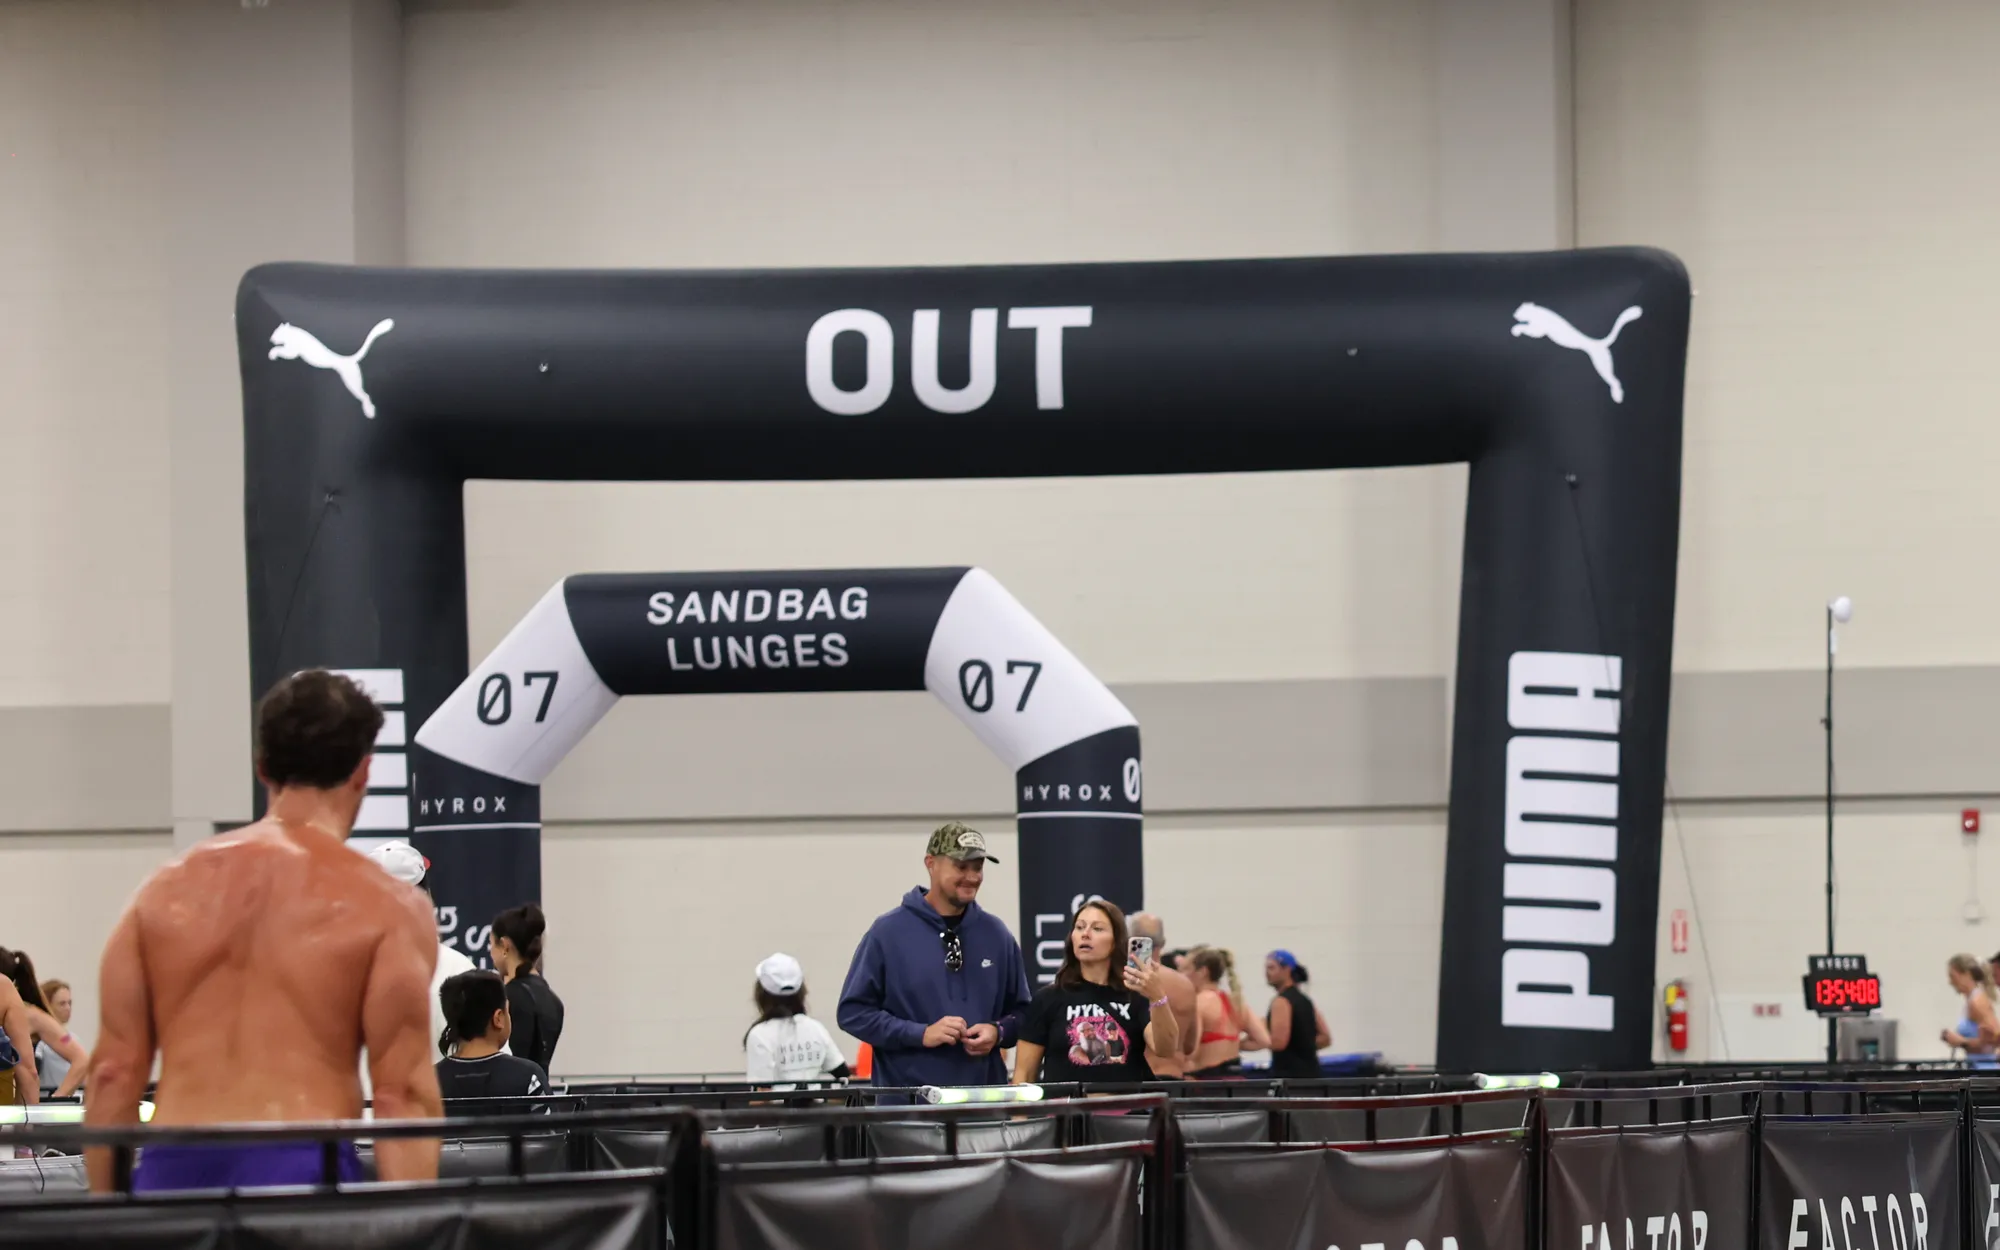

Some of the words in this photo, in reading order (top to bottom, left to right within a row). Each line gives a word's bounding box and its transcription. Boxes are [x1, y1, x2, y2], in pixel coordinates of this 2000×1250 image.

[806, 306, 1092, 415] OUT
[647, 586, 868, 625] SANDBAG
[667, 632, 849, 670] LUNGES
[476, 670, 559, 726] 07
[958, 659, 1042, 714] 07
[420, 796, 506, 814] HYROX
[1023, 783, 1112, 801] HYROX
[1501, 651, 1622, 1031] PUMA
[1816, 978, 1879, 1006] 13:54:08
